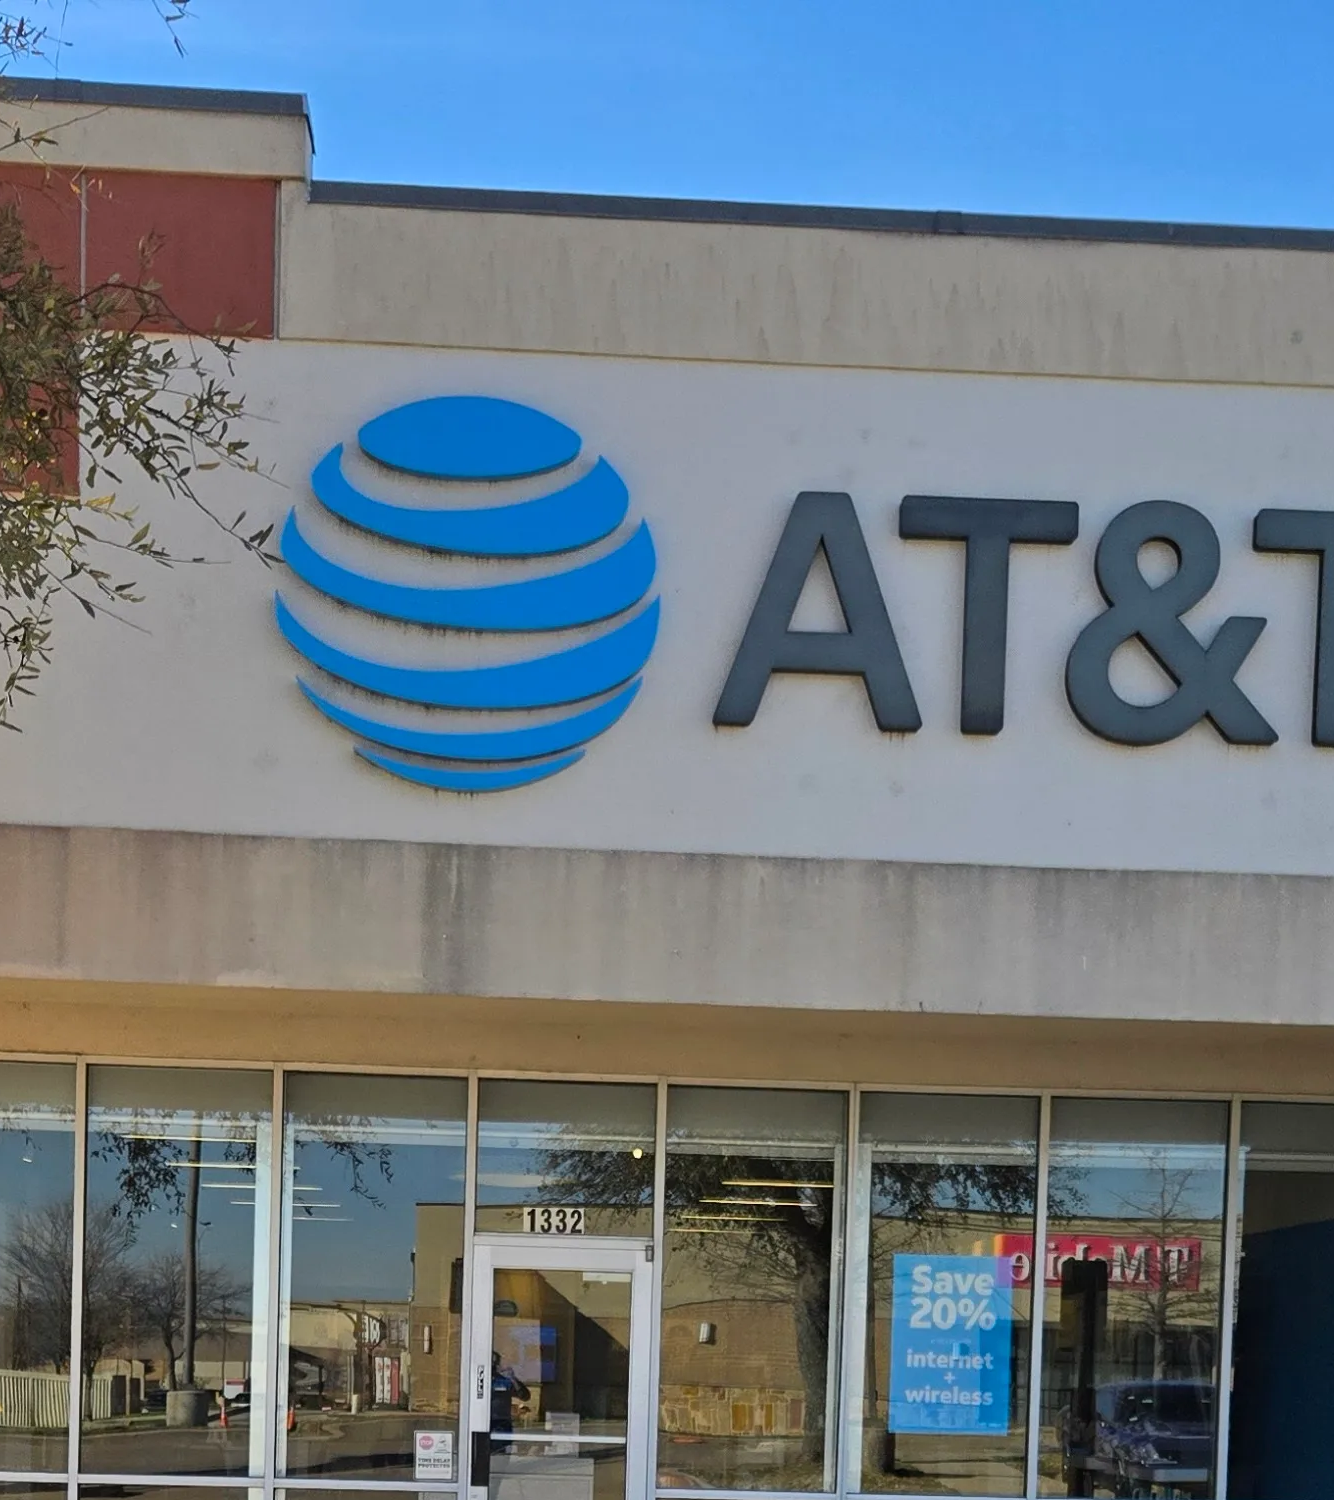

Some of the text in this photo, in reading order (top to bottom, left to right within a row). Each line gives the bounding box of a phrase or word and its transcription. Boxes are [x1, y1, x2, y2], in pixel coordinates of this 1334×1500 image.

[527, 1208, 582, 1234] 1332
[911, 1263, 995, 1297] Save
[909, 1297, 997, 1331] 20%
[906, 1348, 995, 1370] internet
[905, 1385, 994, 1406] wireless
